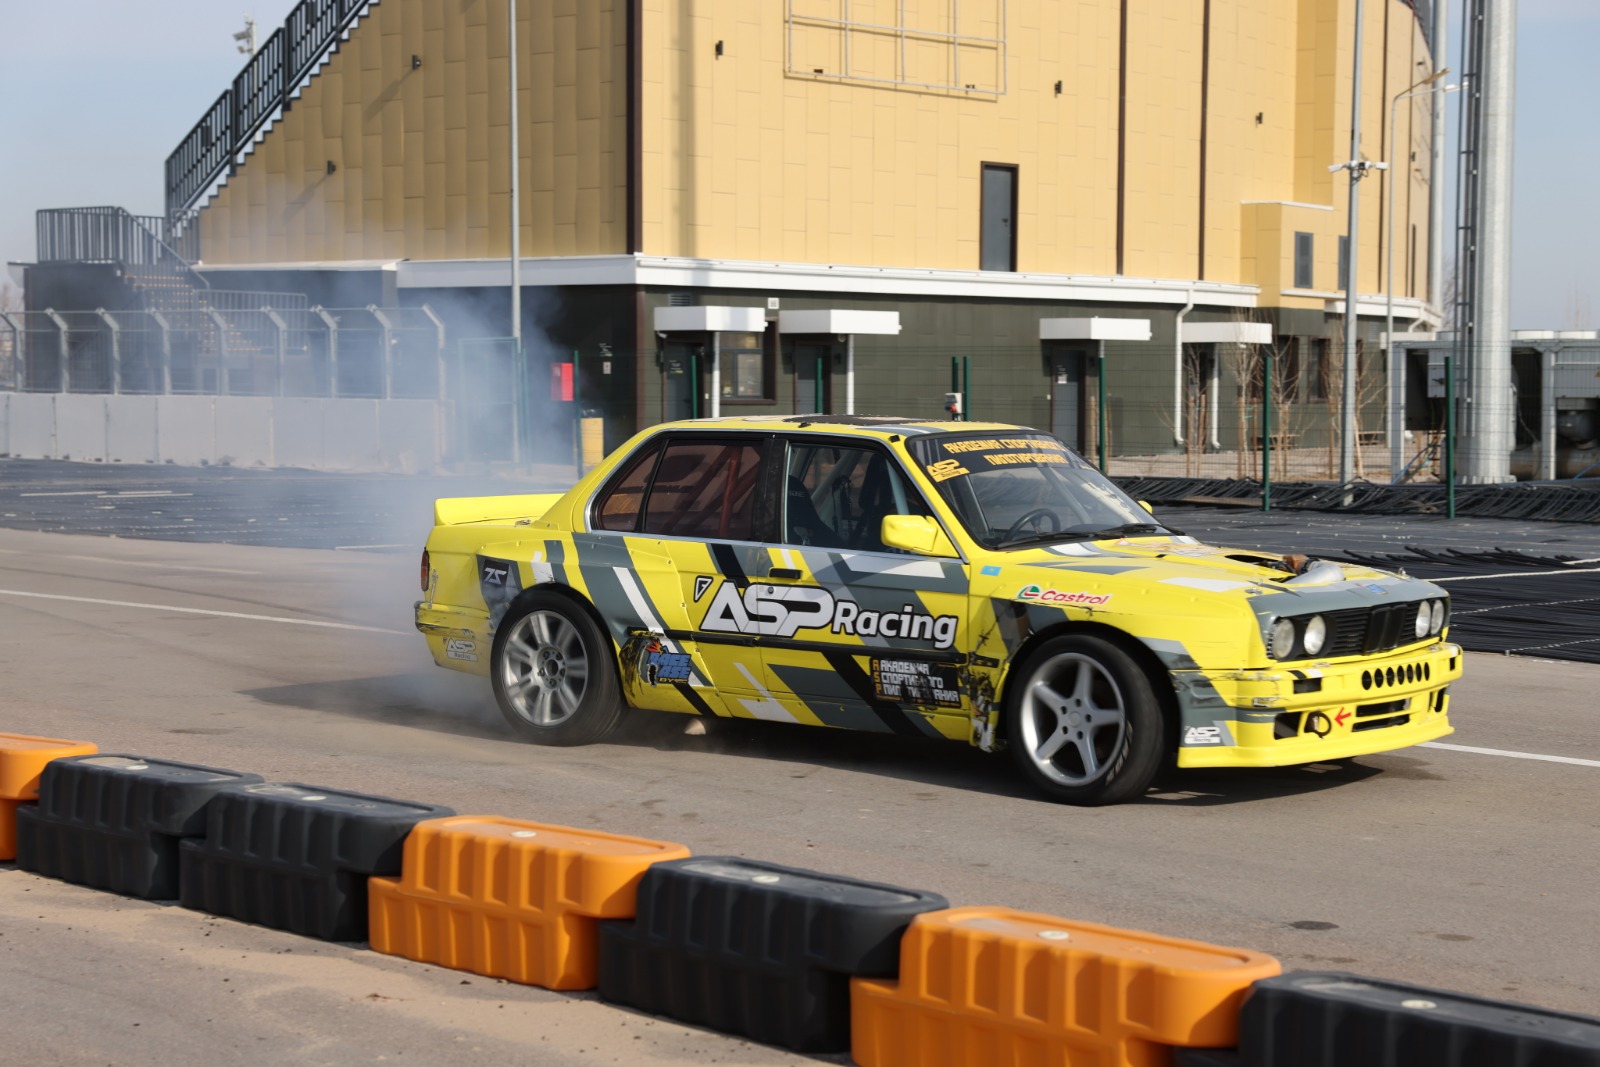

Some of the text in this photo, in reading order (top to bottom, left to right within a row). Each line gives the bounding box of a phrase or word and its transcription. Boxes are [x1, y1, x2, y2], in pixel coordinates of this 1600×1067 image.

[926, 458, 960, 477] ASP
[1041, 590, 1110, 604] Castrol
[699, 579, 958, 649] ASP Racing
[447, 638, 476, 653] ASP
[881, 673, 944, 689] СПОРТИВГО
[883, 684, 959, 702] ПИЛТИАНИЯ
[1184, 727, 1220, 738] ASP
